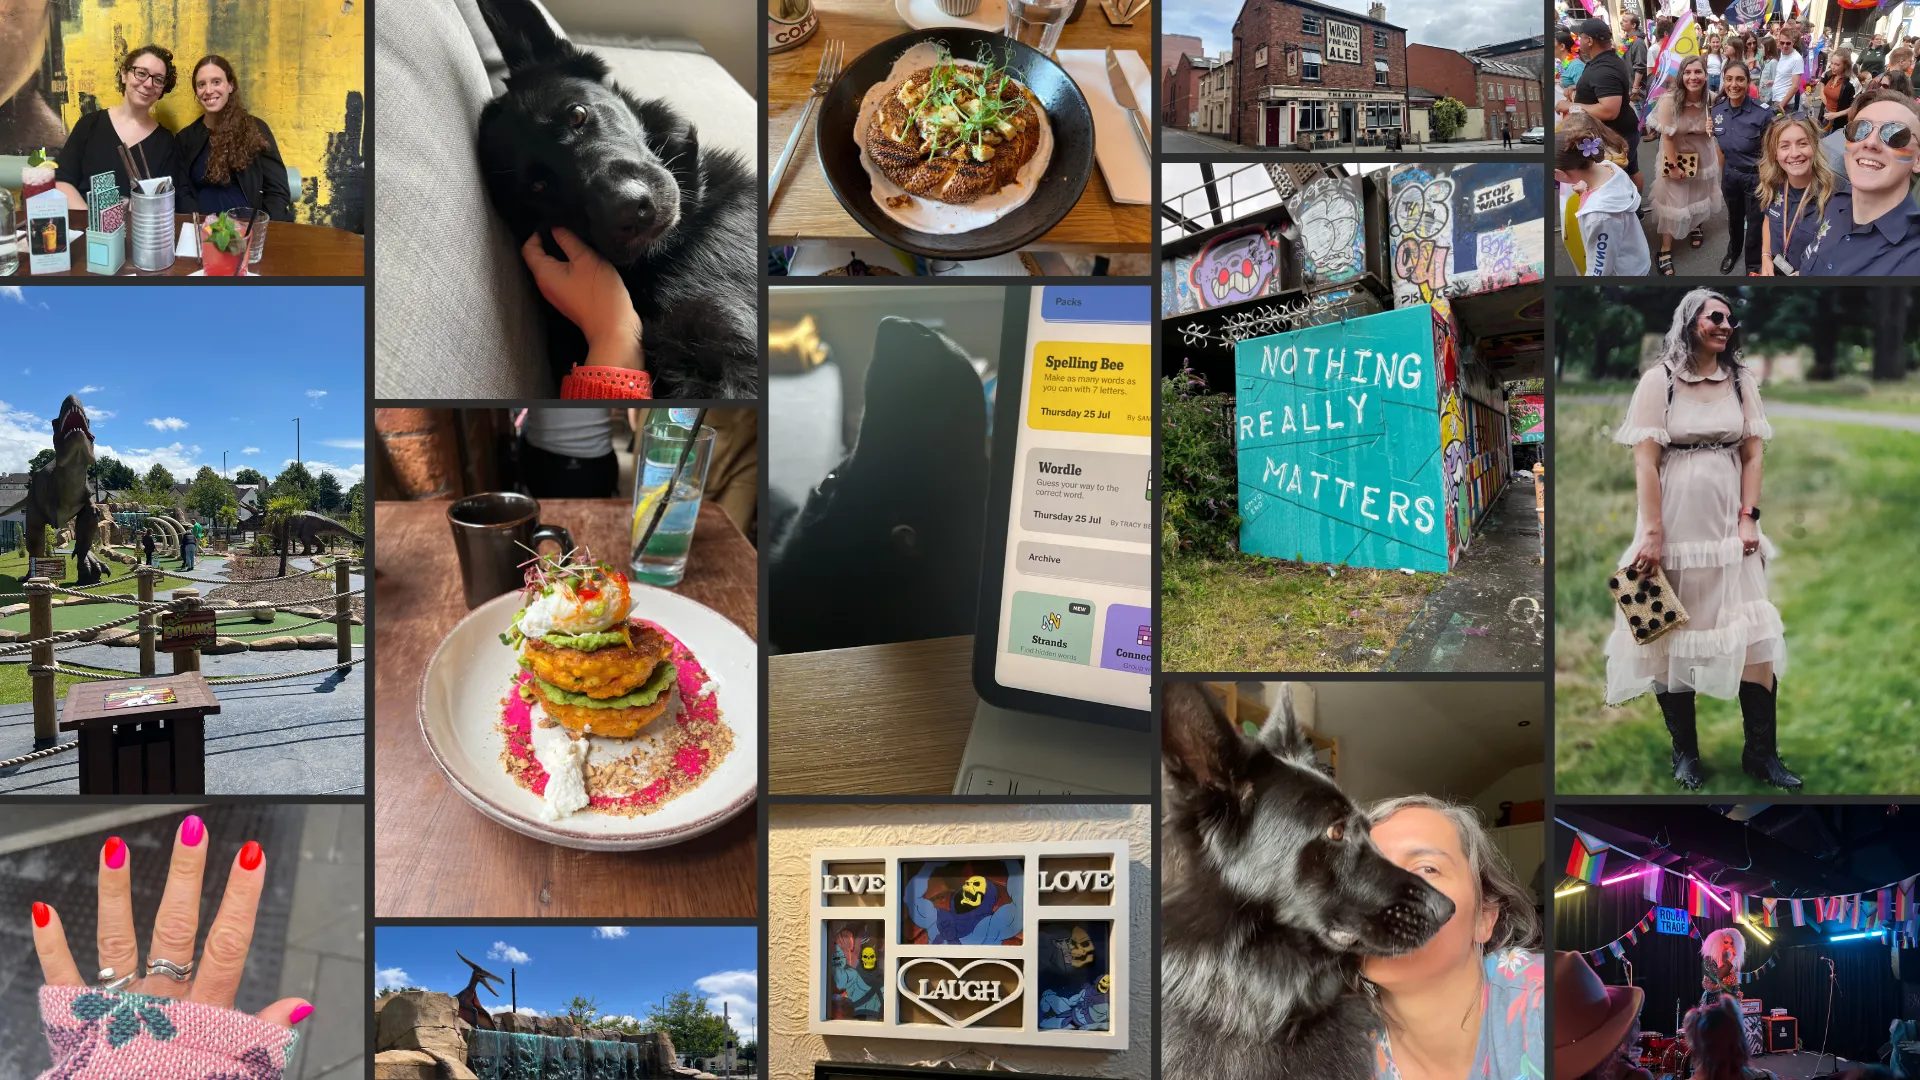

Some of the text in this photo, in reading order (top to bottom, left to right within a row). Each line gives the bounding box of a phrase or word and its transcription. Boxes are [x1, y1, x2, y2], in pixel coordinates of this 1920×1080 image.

[1328, 22, 1358, 41] WARD'S
[1328, 38, 1358, 48] FINE MALT
[1329, 47, 1359, 61] ALES
[1476, 184, 1511, 203] STOP
[1476, 193, 1514, 212] WARS
[1055, 297, 1083, 307] Packs
[1046, 356, 1124, 372] Spelling Bee
[1260, 345, 1422, 389] NOTHING
[1044, 374, 1066, 382] Make
[1078, 376, 1100, 384] many
[1101, 376, 1124, 384] words
[1126, 378, 1136, 386] as
[1074, 386, 1090, 394] with
[1092, 386, 1098, 394] 7
[1100, 386, 1127, 395] letters.
[1041, 407, 1082, 418] Thursday
[1084, 410, 1096, 418] 25
[1097, 410, 1111, 419] Jul
[1240, 392, 1368, 440] REALLY
[1038, 461, 1082, 476] Wordle
[1036, 478, 1060, 488] Guess
[1061, 481, 1078, 489] your
[1080, 483, 1095, 492] way
[1106, 484, 1120, 492] the
[1036, 490, 1084, 500] correct word.
[1262, 456, 1436, 534] MATTERS
[1034, 510, 1074, 522] Thursday
[1074, 514, 1087, 523] 25
[1088, 516, 1102, 524] Jul
[1120, 520, 1142, 528] TRACY
[1028, 553, 1062, 564] Archive
[163, 622, 215, 638] ENTRANCE
[1032, 634, 1068, 649] Strands
[1020, 646, 1077, 661] Find hidden words
[1123, 662, 1144, 672] Group
[822, 870, 1114, 894] LIVE LOVE
[1660, 920, 1686, 933] TRADE
[918, 978, 1002, 1002] LAUGH
